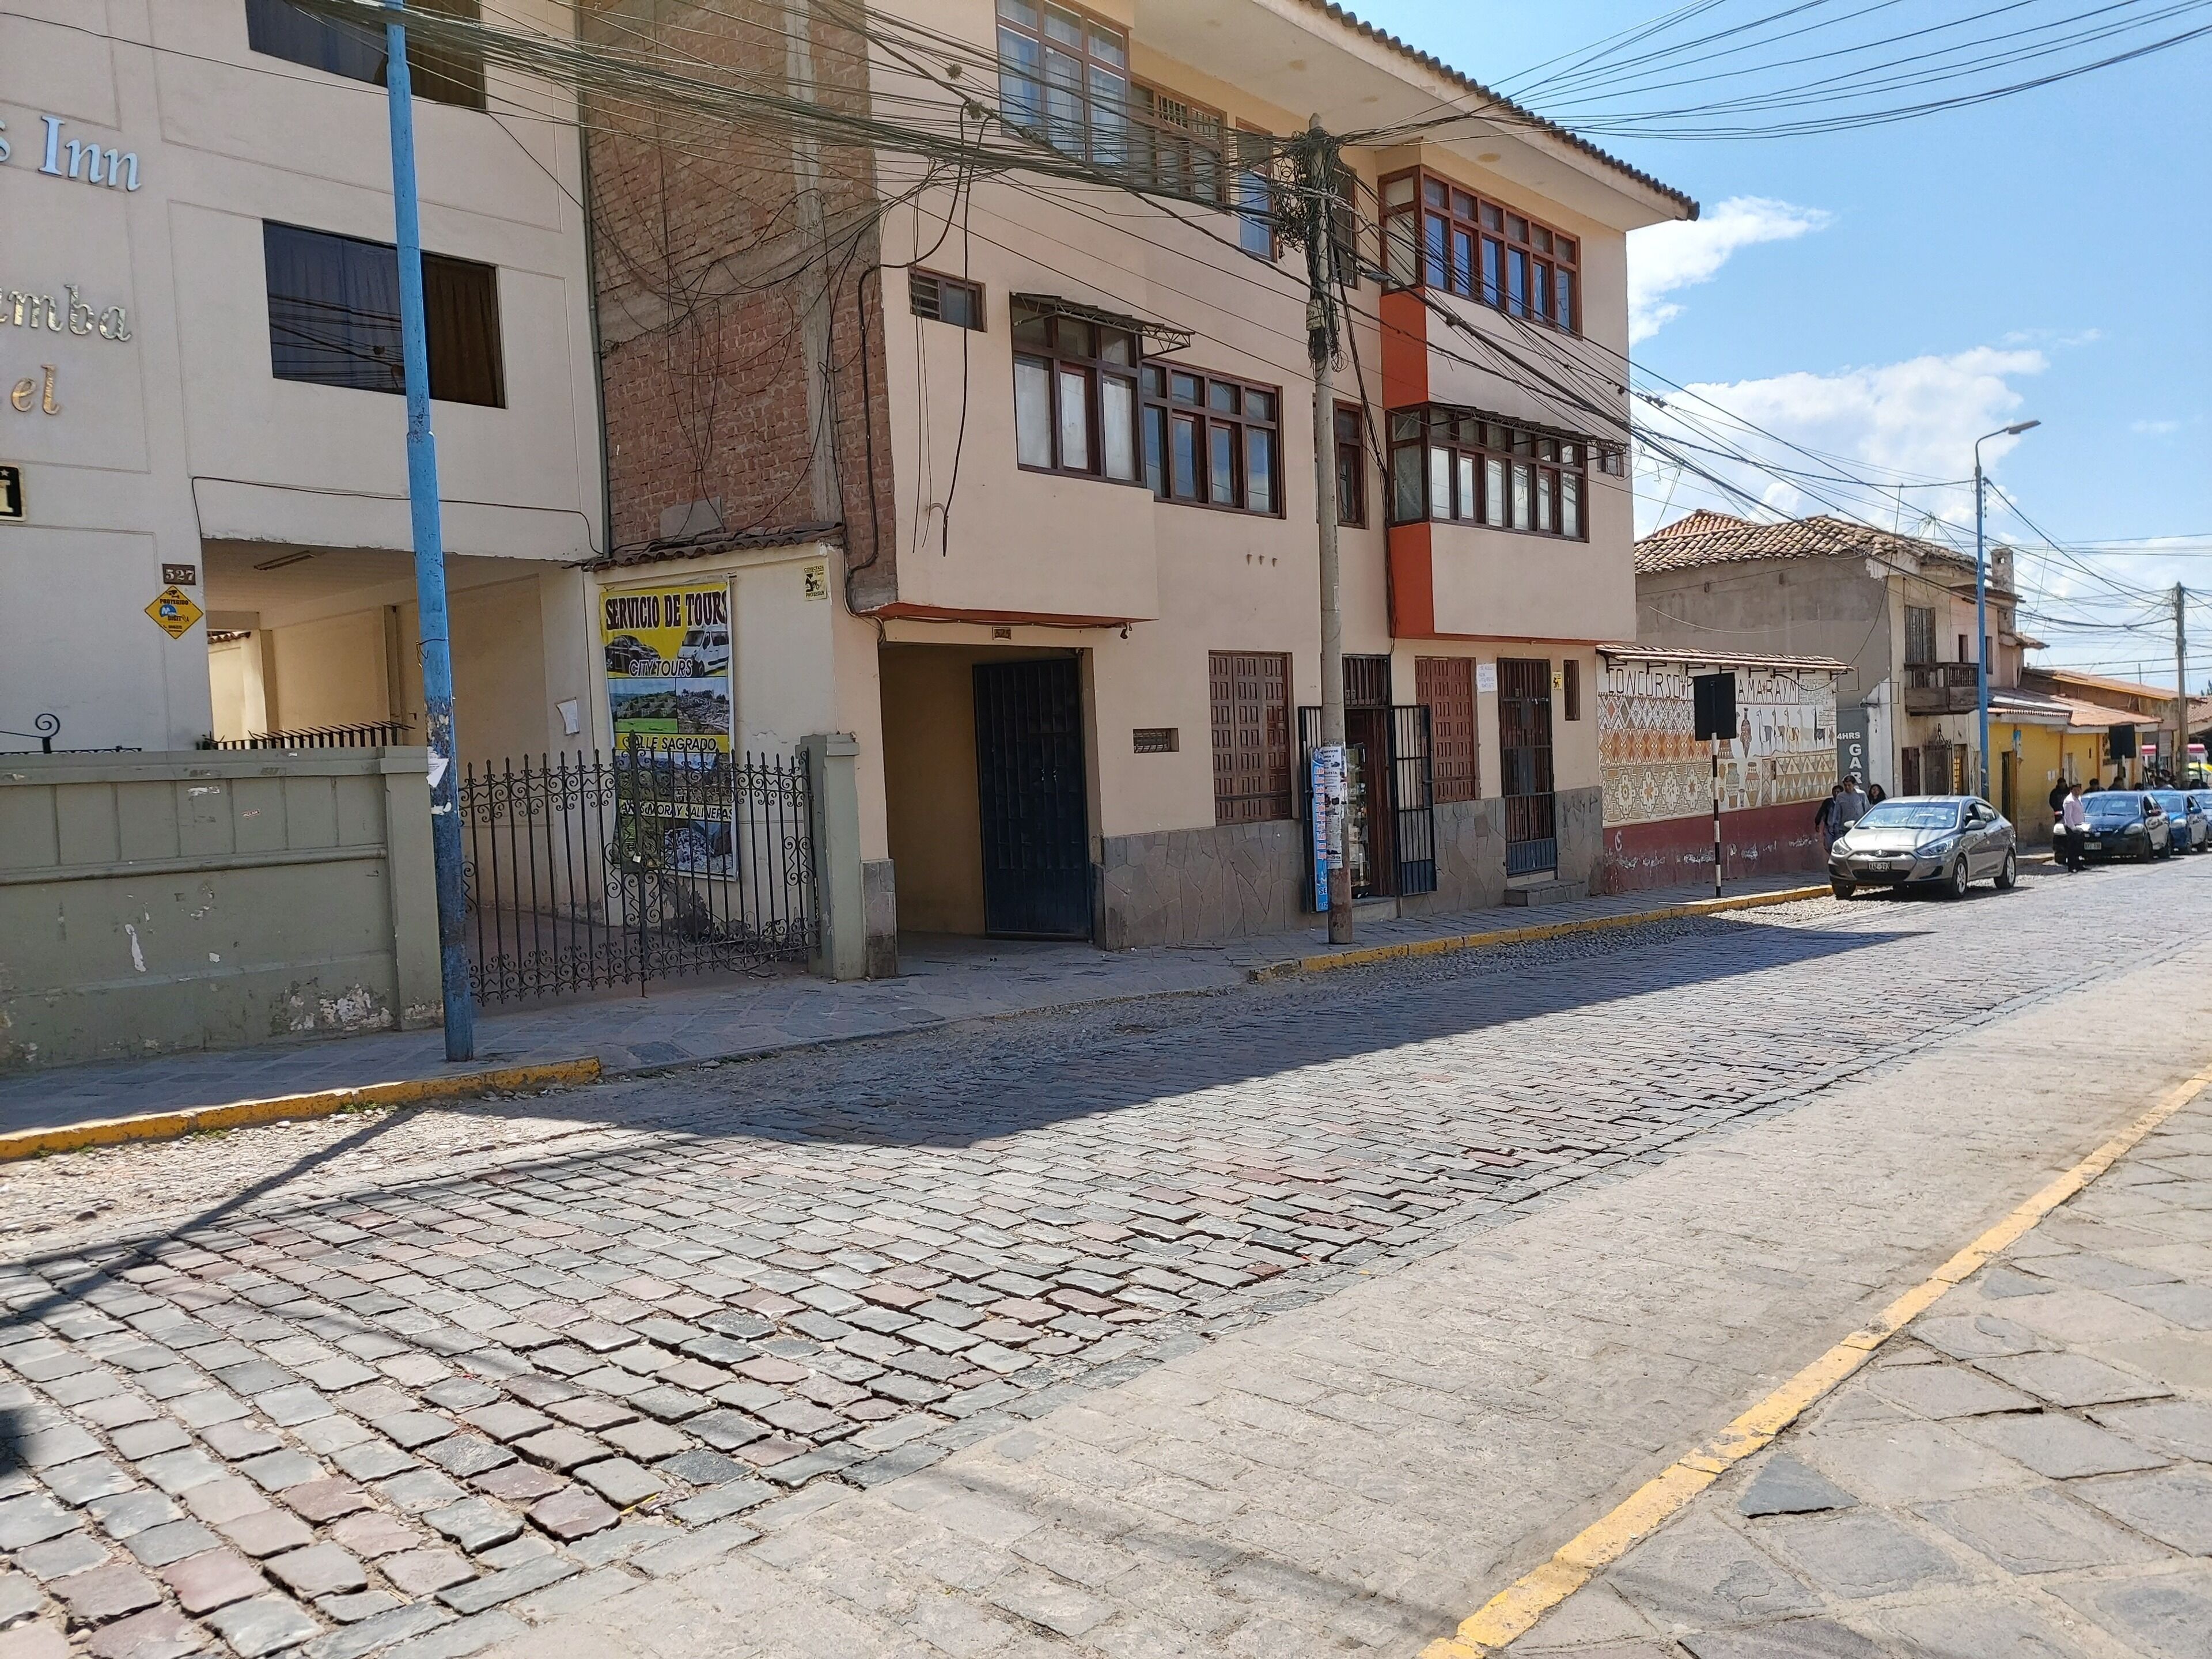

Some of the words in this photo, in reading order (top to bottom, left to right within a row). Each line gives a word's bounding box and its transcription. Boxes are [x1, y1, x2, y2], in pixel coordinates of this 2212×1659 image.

[38, 115, 142, 192] Inn
[0, 283, 132, 342] mba
[166, 569, 194, 581] 527
[605, 596, 660, 631] SERVICIO
[664, 594, 681, 627] DE
[685, 590, 728, 626] TOURS
[629, 659, 654, 677] CITY
[654, 660, 692, 677] TOURS
[1608, 668, 1680, 698] CONCURSO
[628, 736, 658, 749] ALLE
[662, 737, 717, 751] SAGRADO
[1836, 732, 1861, 740] 4HRS
